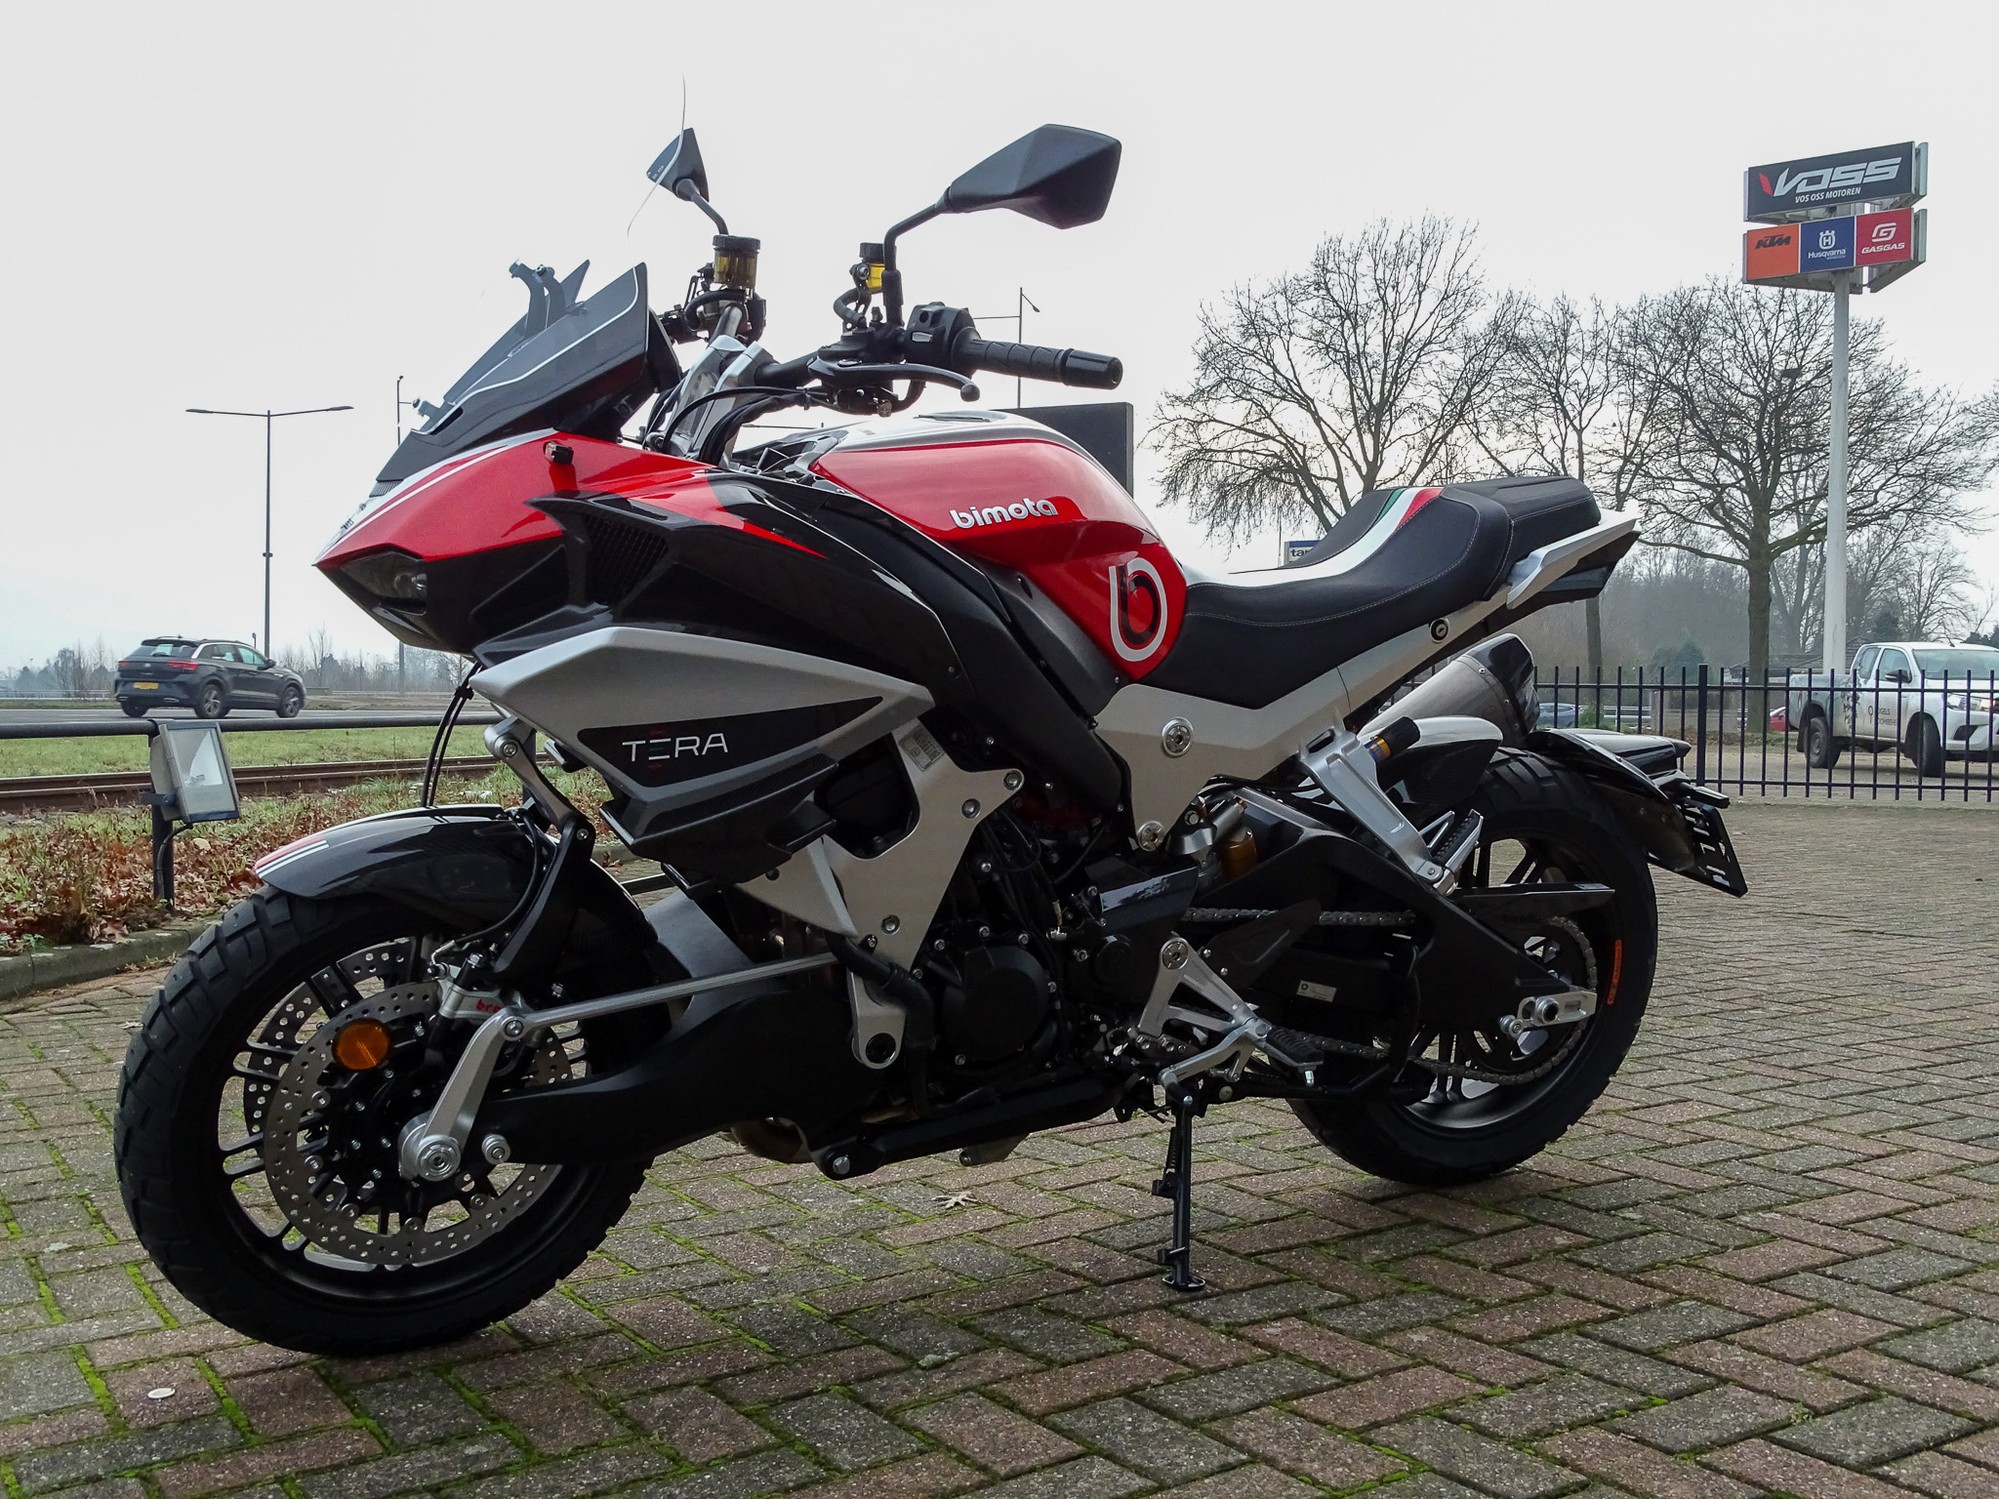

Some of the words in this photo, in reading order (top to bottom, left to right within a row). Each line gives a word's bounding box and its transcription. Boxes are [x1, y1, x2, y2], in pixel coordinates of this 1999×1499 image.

[1759, 157, 1902, 196] VOSS
[1795, 194, 1810, 204] VOS
[1810, 191, 1825, 201] OSS
[1825, 187, 1861, 199] MOTOREN
[1755, 234, 1792, 249] KTM
[1861, 242, 1905, 254] GASGAS
[1808, 248, 1847, 259] Husqvarna
[949, 498, 1059, 530] bimota
[622, 732, 729, 762] TERA
